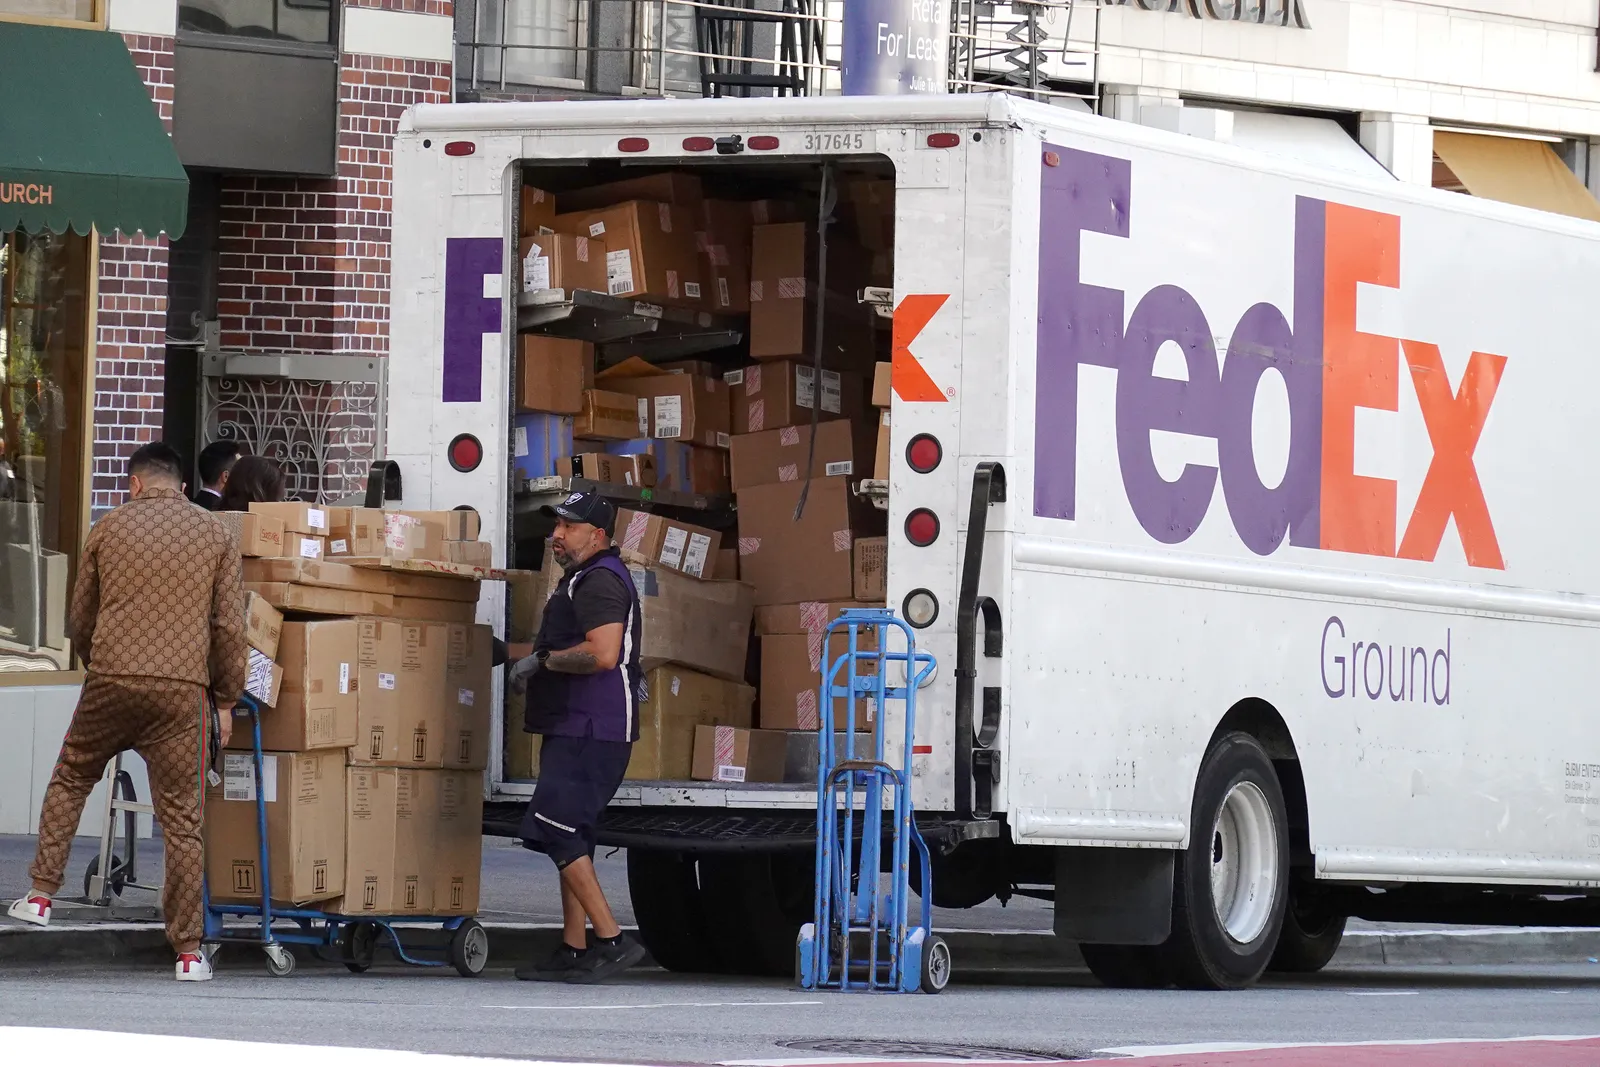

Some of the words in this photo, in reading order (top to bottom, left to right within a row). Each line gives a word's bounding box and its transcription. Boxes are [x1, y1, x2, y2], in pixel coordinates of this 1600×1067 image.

[877, 22, 904, 57] For
[804, 133, 863, 150] 317645
[0, 182, 52, 205] URCH
[1033, 141, 1508, 571] FedEx
[1320, 615, 1451, 706] Ground
